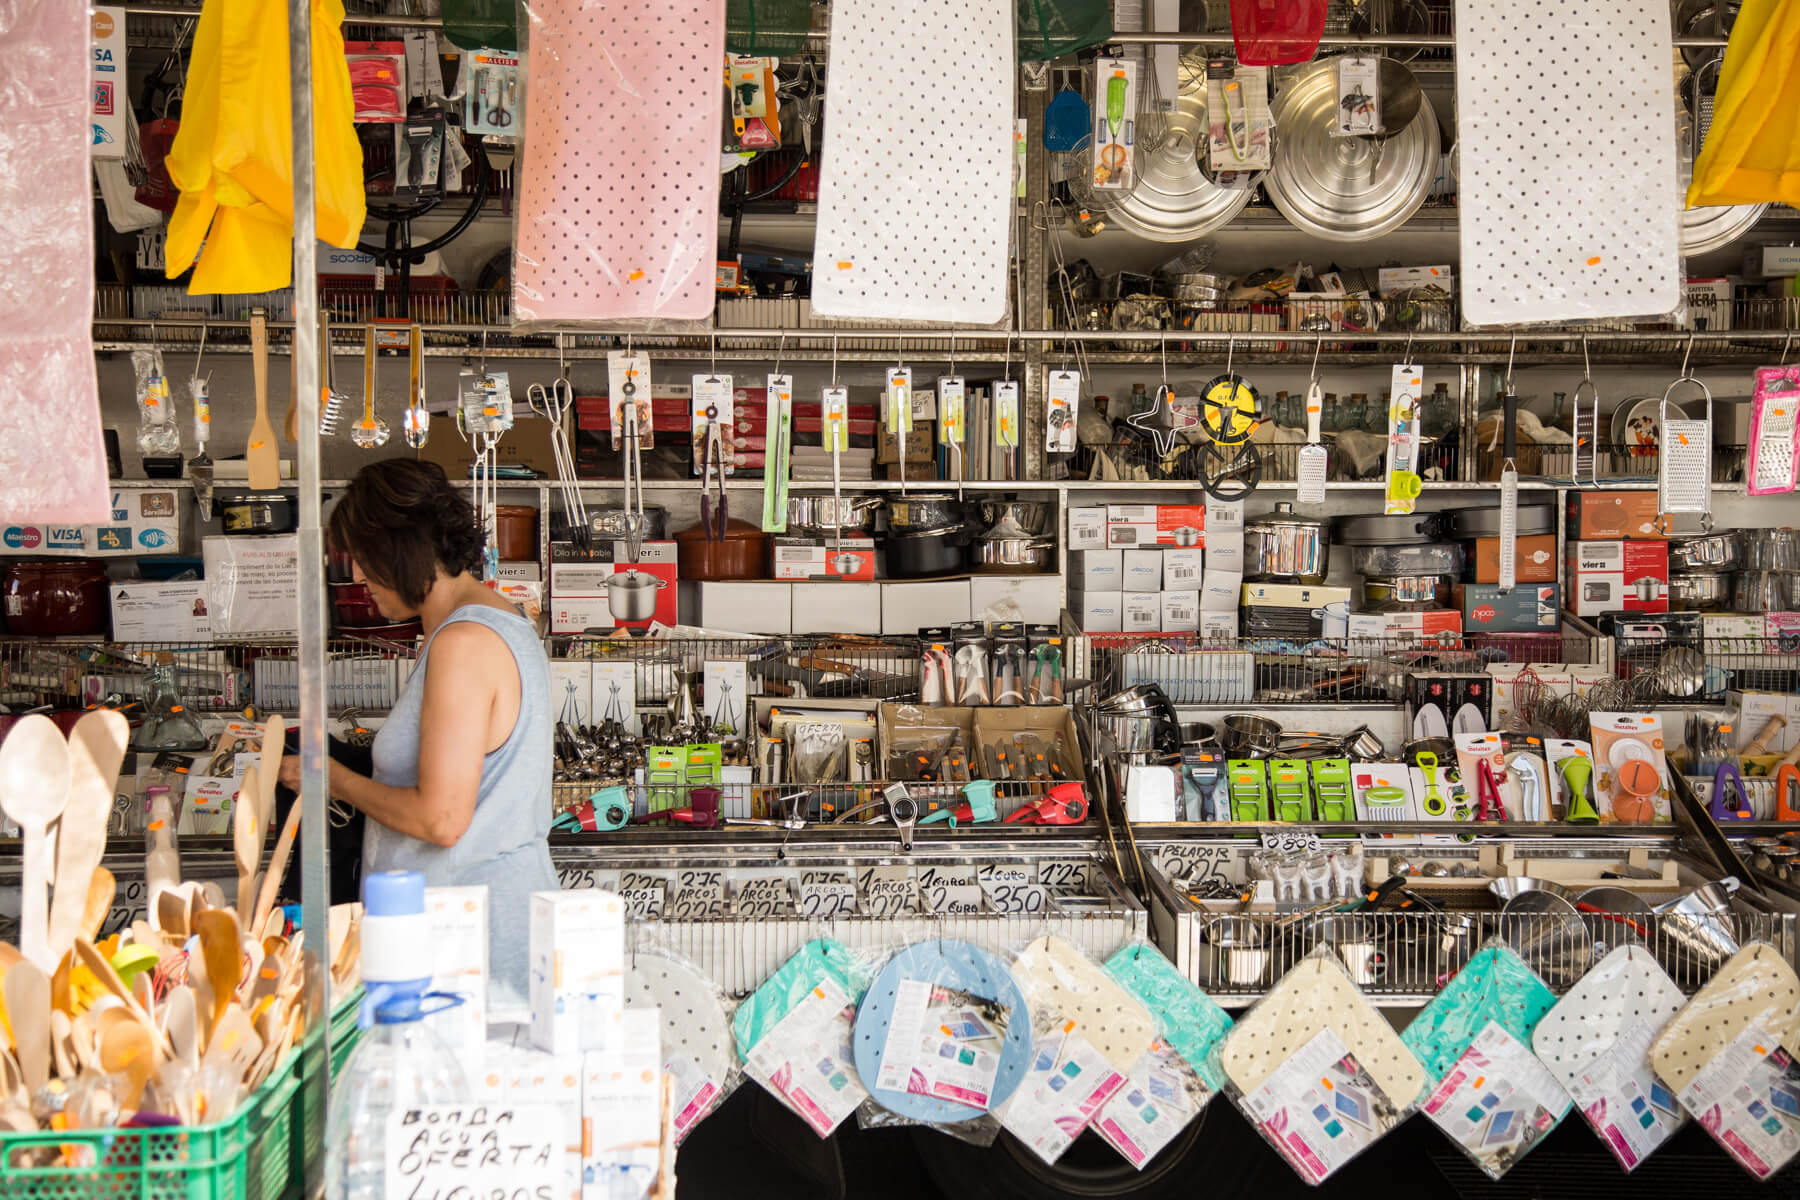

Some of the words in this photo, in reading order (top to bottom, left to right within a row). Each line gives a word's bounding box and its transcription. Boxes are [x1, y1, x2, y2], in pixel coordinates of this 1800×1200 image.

[95, 49, 113, 61] SA
[7, 533, 39, 541] Maestro
[52, 529, 83, 540] VISA
[499, 568, 517, 576] vier
[1162, 844, 1229, 858] PELADOR
[919, 868, 936, 889] 1
[979, 864, 997, 881] 1
[1040, 863, 1087, 886] 1'25
[739, 887, 780, 901] ARCOS
[806, 886, 847, 895] ARCOS
[871, 881, 912, 895] ARCOS
[675, 887, 717, 905] ARCOS
[398, 1142, 552, 1175] OFERTA
